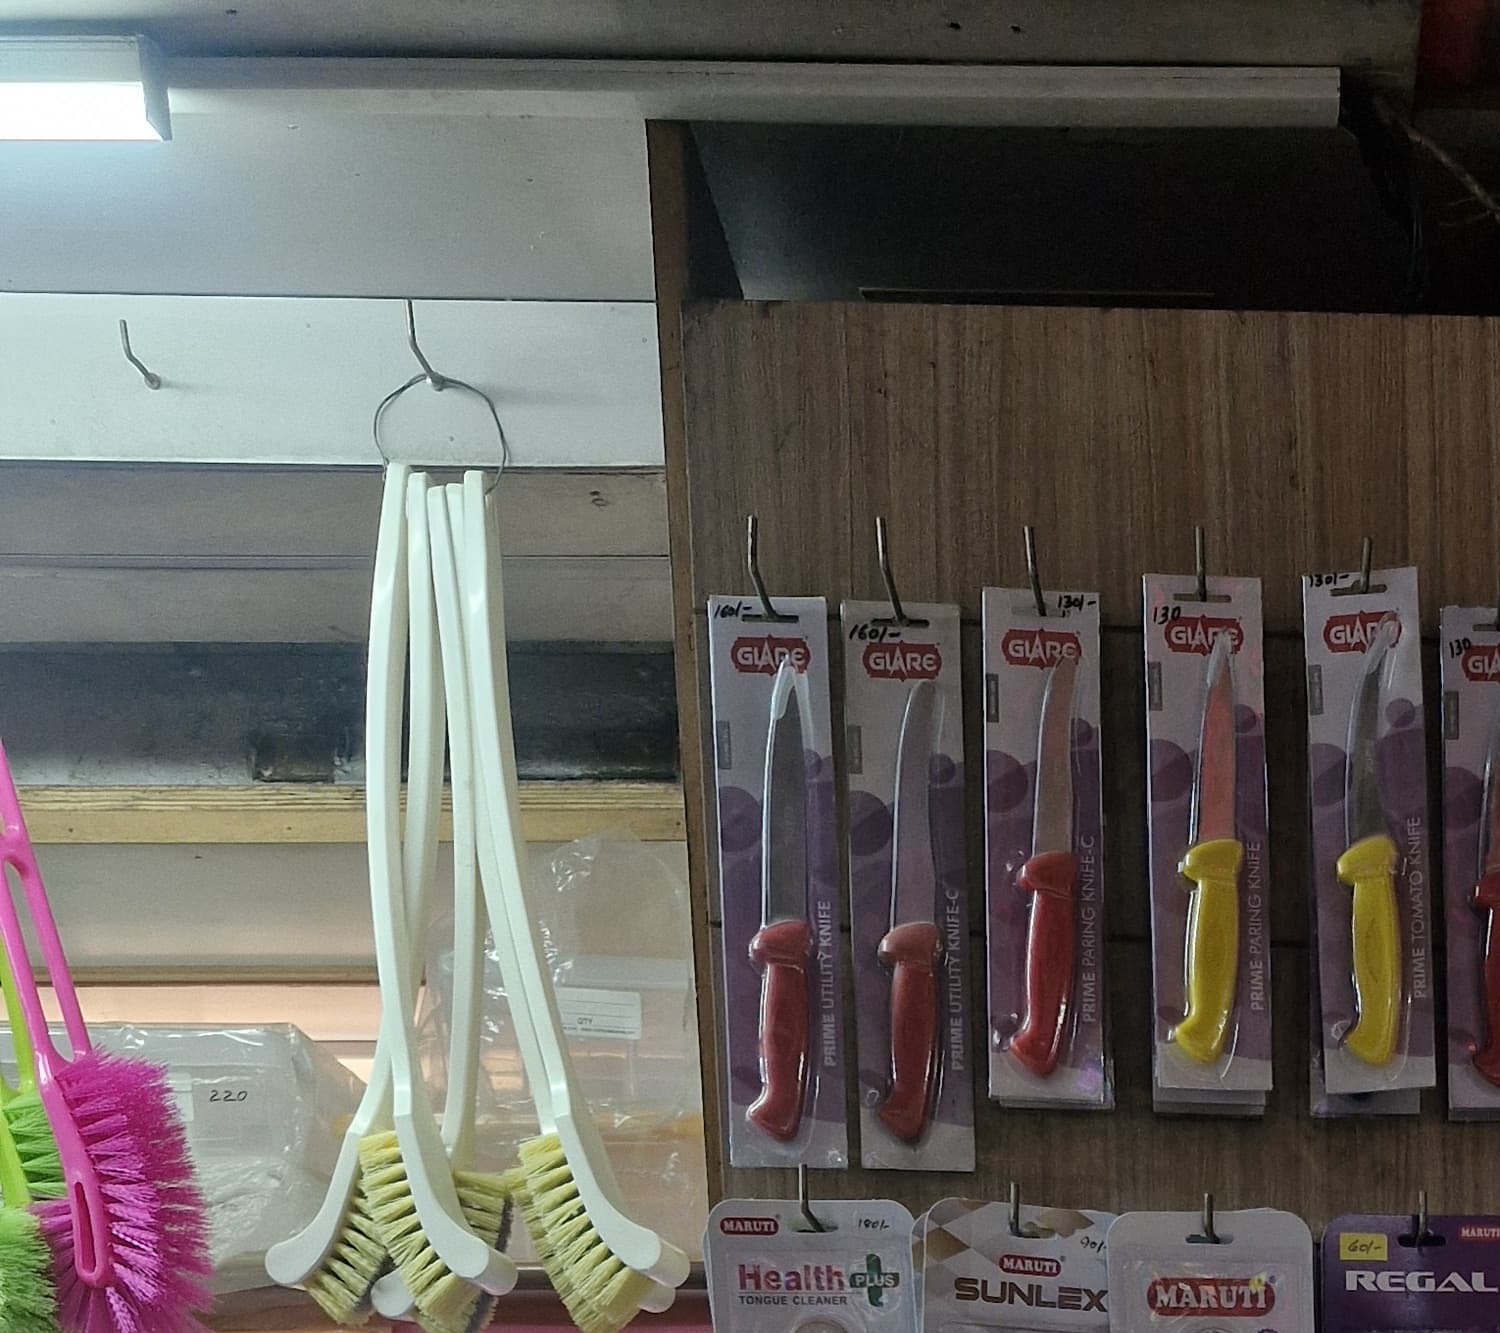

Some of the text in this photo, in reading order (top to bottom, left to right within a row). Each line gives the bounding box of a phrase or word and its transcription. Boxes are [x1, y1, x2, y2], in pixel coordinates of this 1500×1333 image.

[1058, 594, 1096, 608] 130/-
[714, 604, 752, 619] 160/-
[1153, 606, 1181, 624] 130
[849, 626, 900, 641] 160/-
[1009, 633, 1076, 663] GLARE
[1450, 639, 1471, 657] 130
[869, 646, 937, 674] GLARE
[1408, 816, 1427, 998] PRIME TOMATO KNIFE
[1081, 836, 1096, 1023] PRIME PARING KNIFE-C
[1248, 841, 1264, 1010] PRIME PARING KNIFE
[819, 901, 836, 1066] PRIME UTILITY KNIFE
[946, 890, 965, 1071] PRIME UTILITY KNIFE-C
[210, 1090, 247, 1102] 220
[723, 1220, 775, 1232] MARUTI
[858, 1218, 890, 1231] 180/-
[1461, 1225, 1500, 1239] MARUTI
[1002, 1257, 1059, 1274] MARUTI
[739, 1264, 895, 1292] Health PLUS
[1345, 1270, 1499, 1293] REGAL
[739, 1295, 848, 1305] TONGUE CLEANER
[954, 1278, 1108, 1312] SUNLEX
[1156, 1278, 1265, 1310] MARUTI
